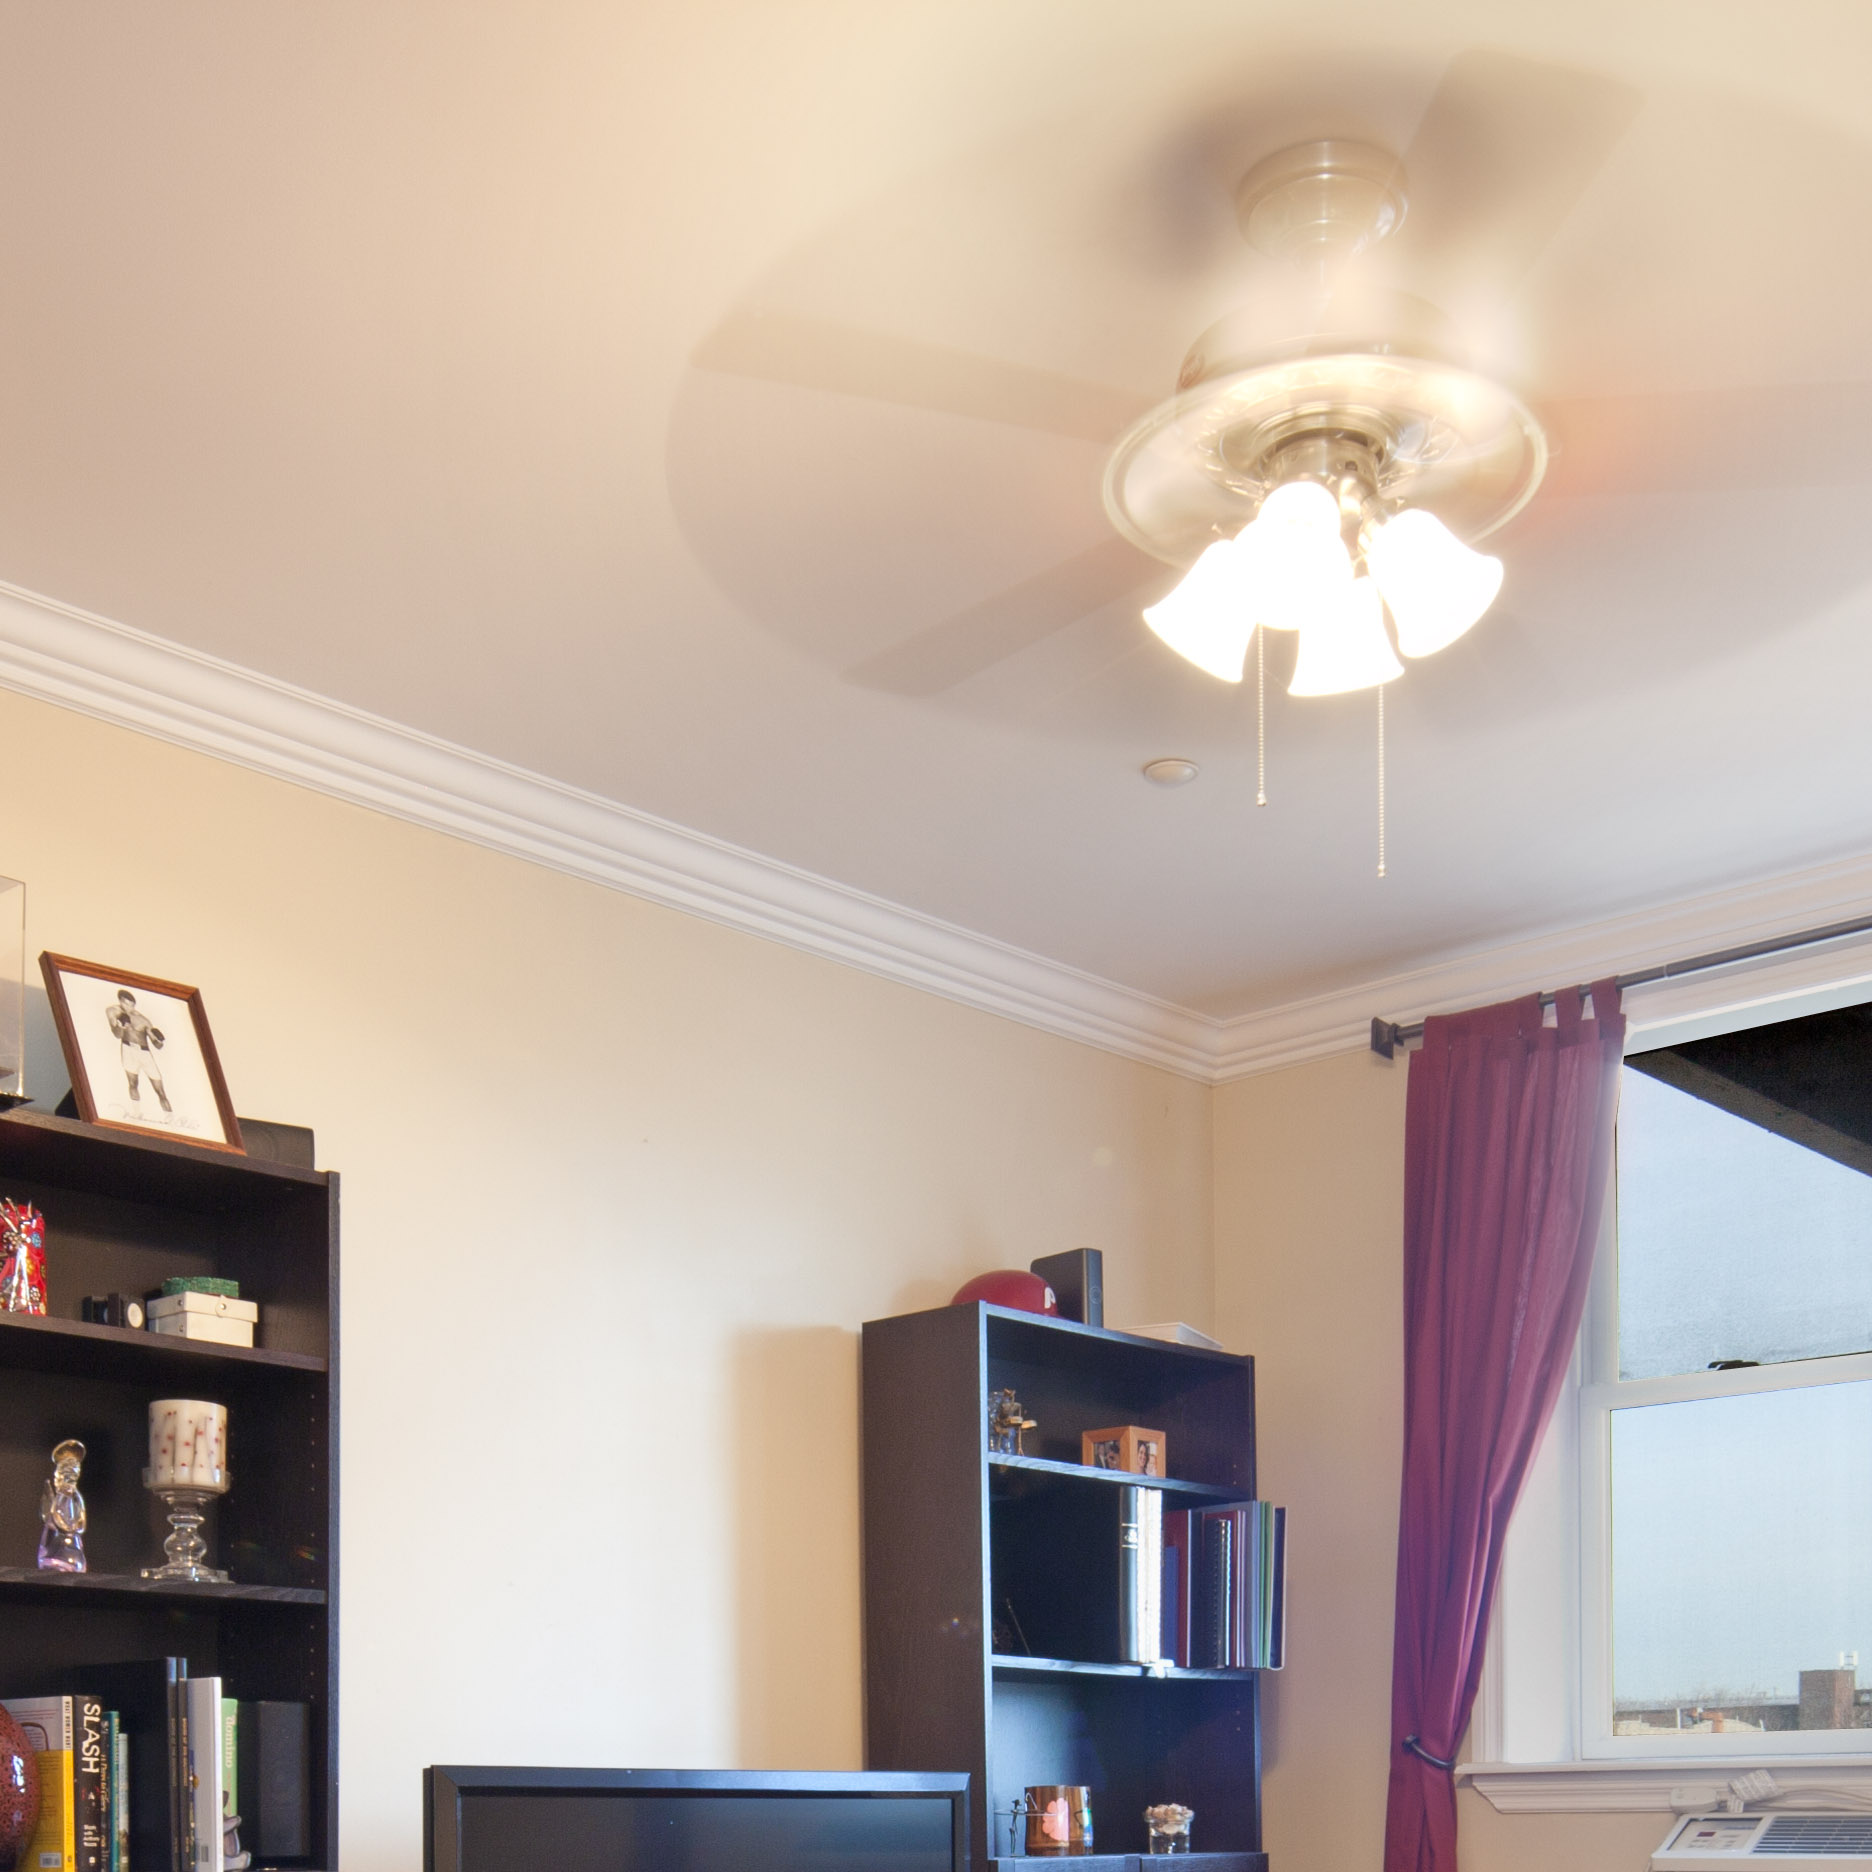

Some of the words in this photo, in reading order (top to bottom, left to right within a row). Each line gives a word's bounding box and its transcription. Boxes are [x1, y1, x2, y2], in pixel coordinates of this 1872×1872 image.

[1044, 1287, 1056, 1309] P
[82, 1703, 101, 1773] SLASH
[225, 1715, 237, 1768] domino
